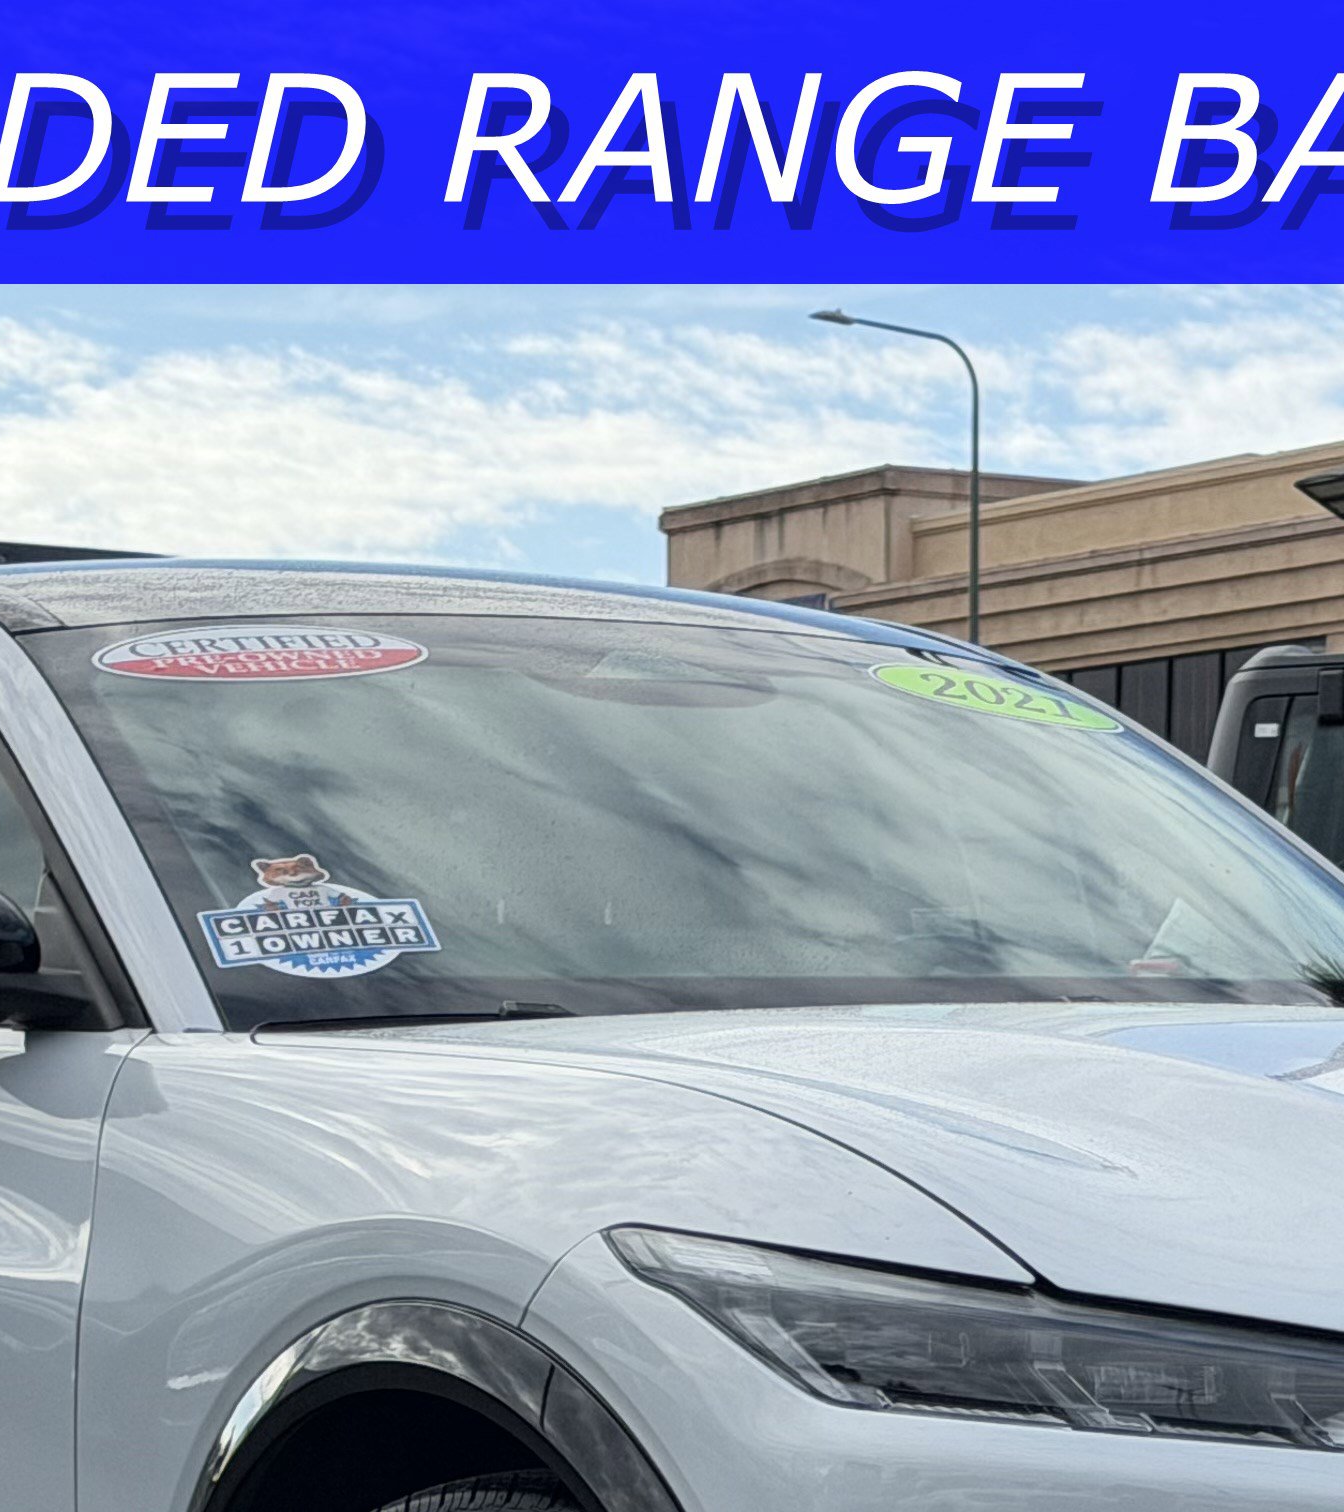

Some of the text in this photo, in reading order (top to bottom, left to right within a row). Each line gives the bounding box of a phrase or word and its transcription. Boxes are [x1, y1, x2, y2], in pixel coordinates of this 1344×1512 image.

[128, 634, 381, 658] CERTIFIED
[153, 649, 383, 670] PRE-OWNED
[196, 659, 362, 675] VEHICLE
[919, 672, 1082, 722] 2021
[288, 890, 320, 900] CAR
[220, 908, 410, 935] CARFAX
[228, 927, 420, 957] 1 OWNER
